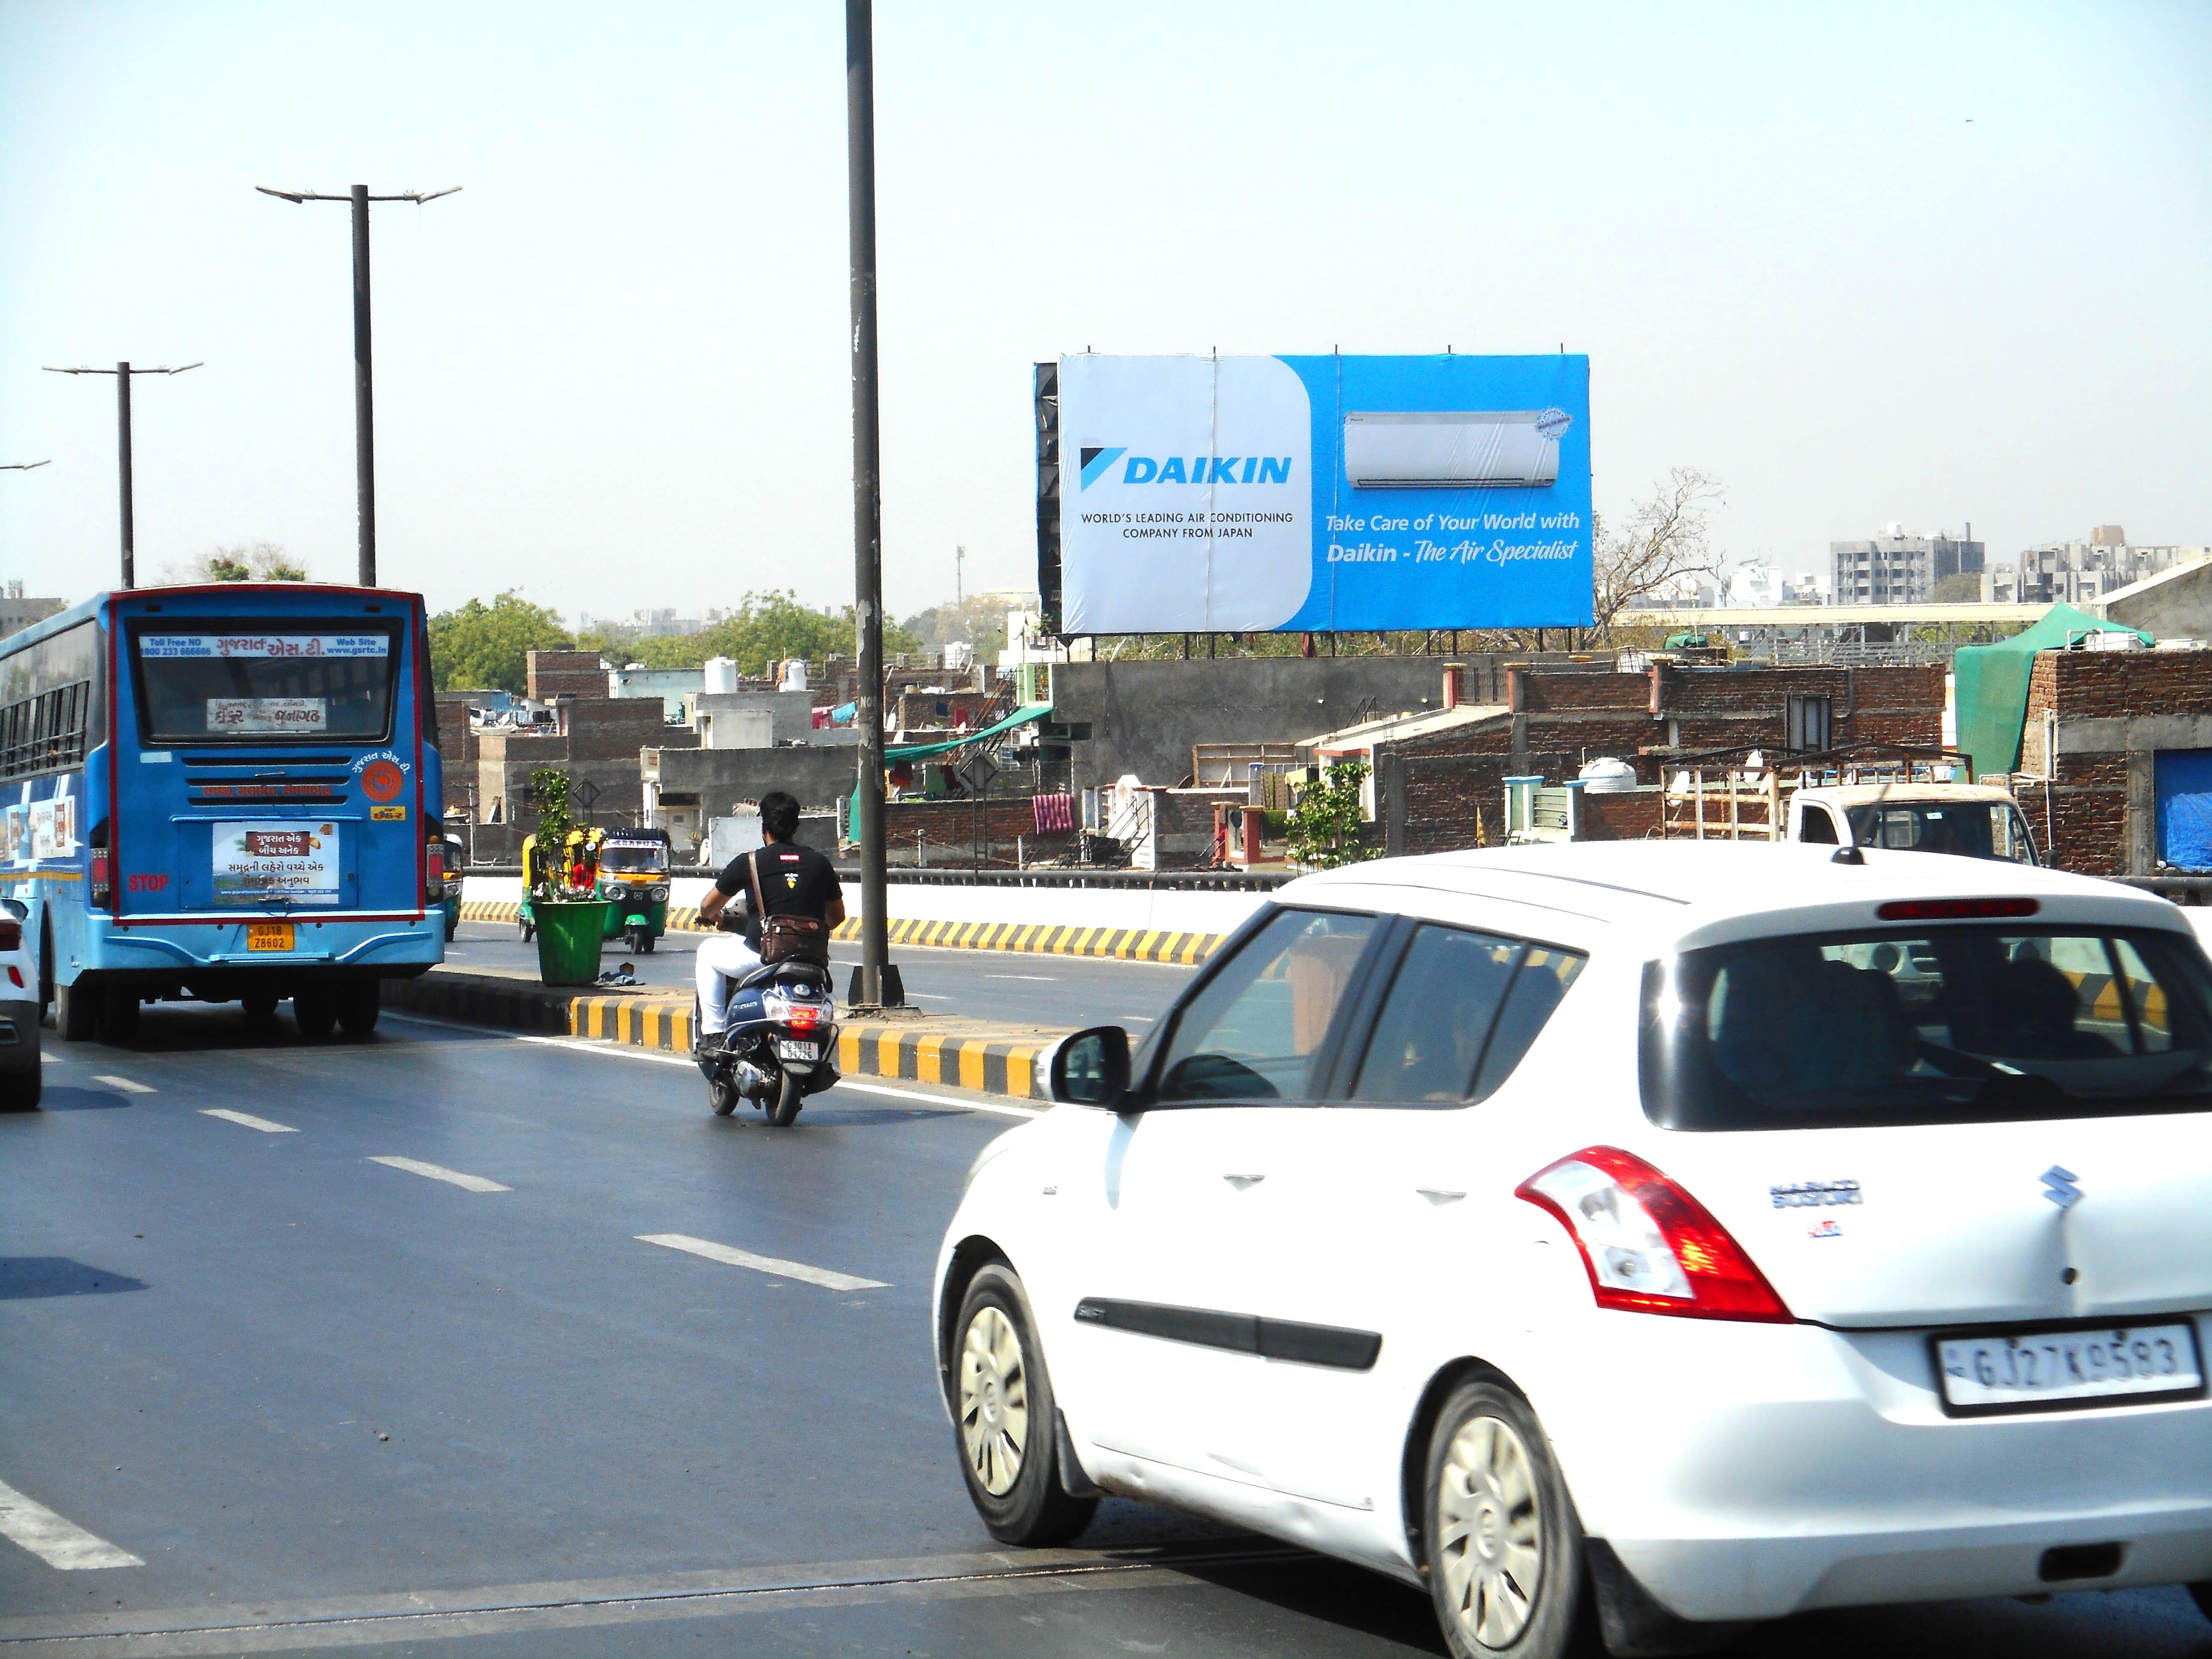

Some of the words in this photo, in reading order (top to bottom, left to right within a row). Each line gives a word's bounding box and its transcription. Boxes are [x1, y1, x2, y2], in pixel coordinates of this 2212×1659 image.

[1123, 457, 1291, 484] DAIKIN
[1082, 514, 1131, 523] WORLD'S
[1136, 514, 1184, 523] LEADING
[1187, 513, 1205, 522] AIR
[1210, 513, 1293, 523] CONDITIONING
[1325, 516, 1365, 531] Take
[1371, 516, 1408, 531] Care
[1414, 514, 1433, 530] of
[1438, 514, 1479, 529] Your
[1484, 513, 1535, 529] World
[1540, 512, 1580, 529] with
[1123, 529, 1178, 538] COMPANY
[1183, 529, 1213, 538] FROM
[1218, 529, 1252, 538] JAPAN
[1327, 543, 1397, 562] Daikin
[1414, 540, 1446, 563] The
[1451, 540, 1484, 564] Air
[1486, 539, 1578, 567] Specialist
[327, 646, 386, 655] www.gsrtc.in
[256, 835, 284, 845] ગુજરાત
[286, 833, 301, 842] એક
[278, 846, 299, 854] અનેક
[228, 860, 258, 875] સમુદ્રની
[261, 861, 283, 872] લહેરો
[287, 861, 305, 872] વચ્ચે
[307, 861, 324, 872] એક
[129, 875, 168, 891] STOP
[277, 876, 310, 887] અનુભવ
[258, 926, 282, 936] GJ18
[255, 938, 285, 948] Z8602
